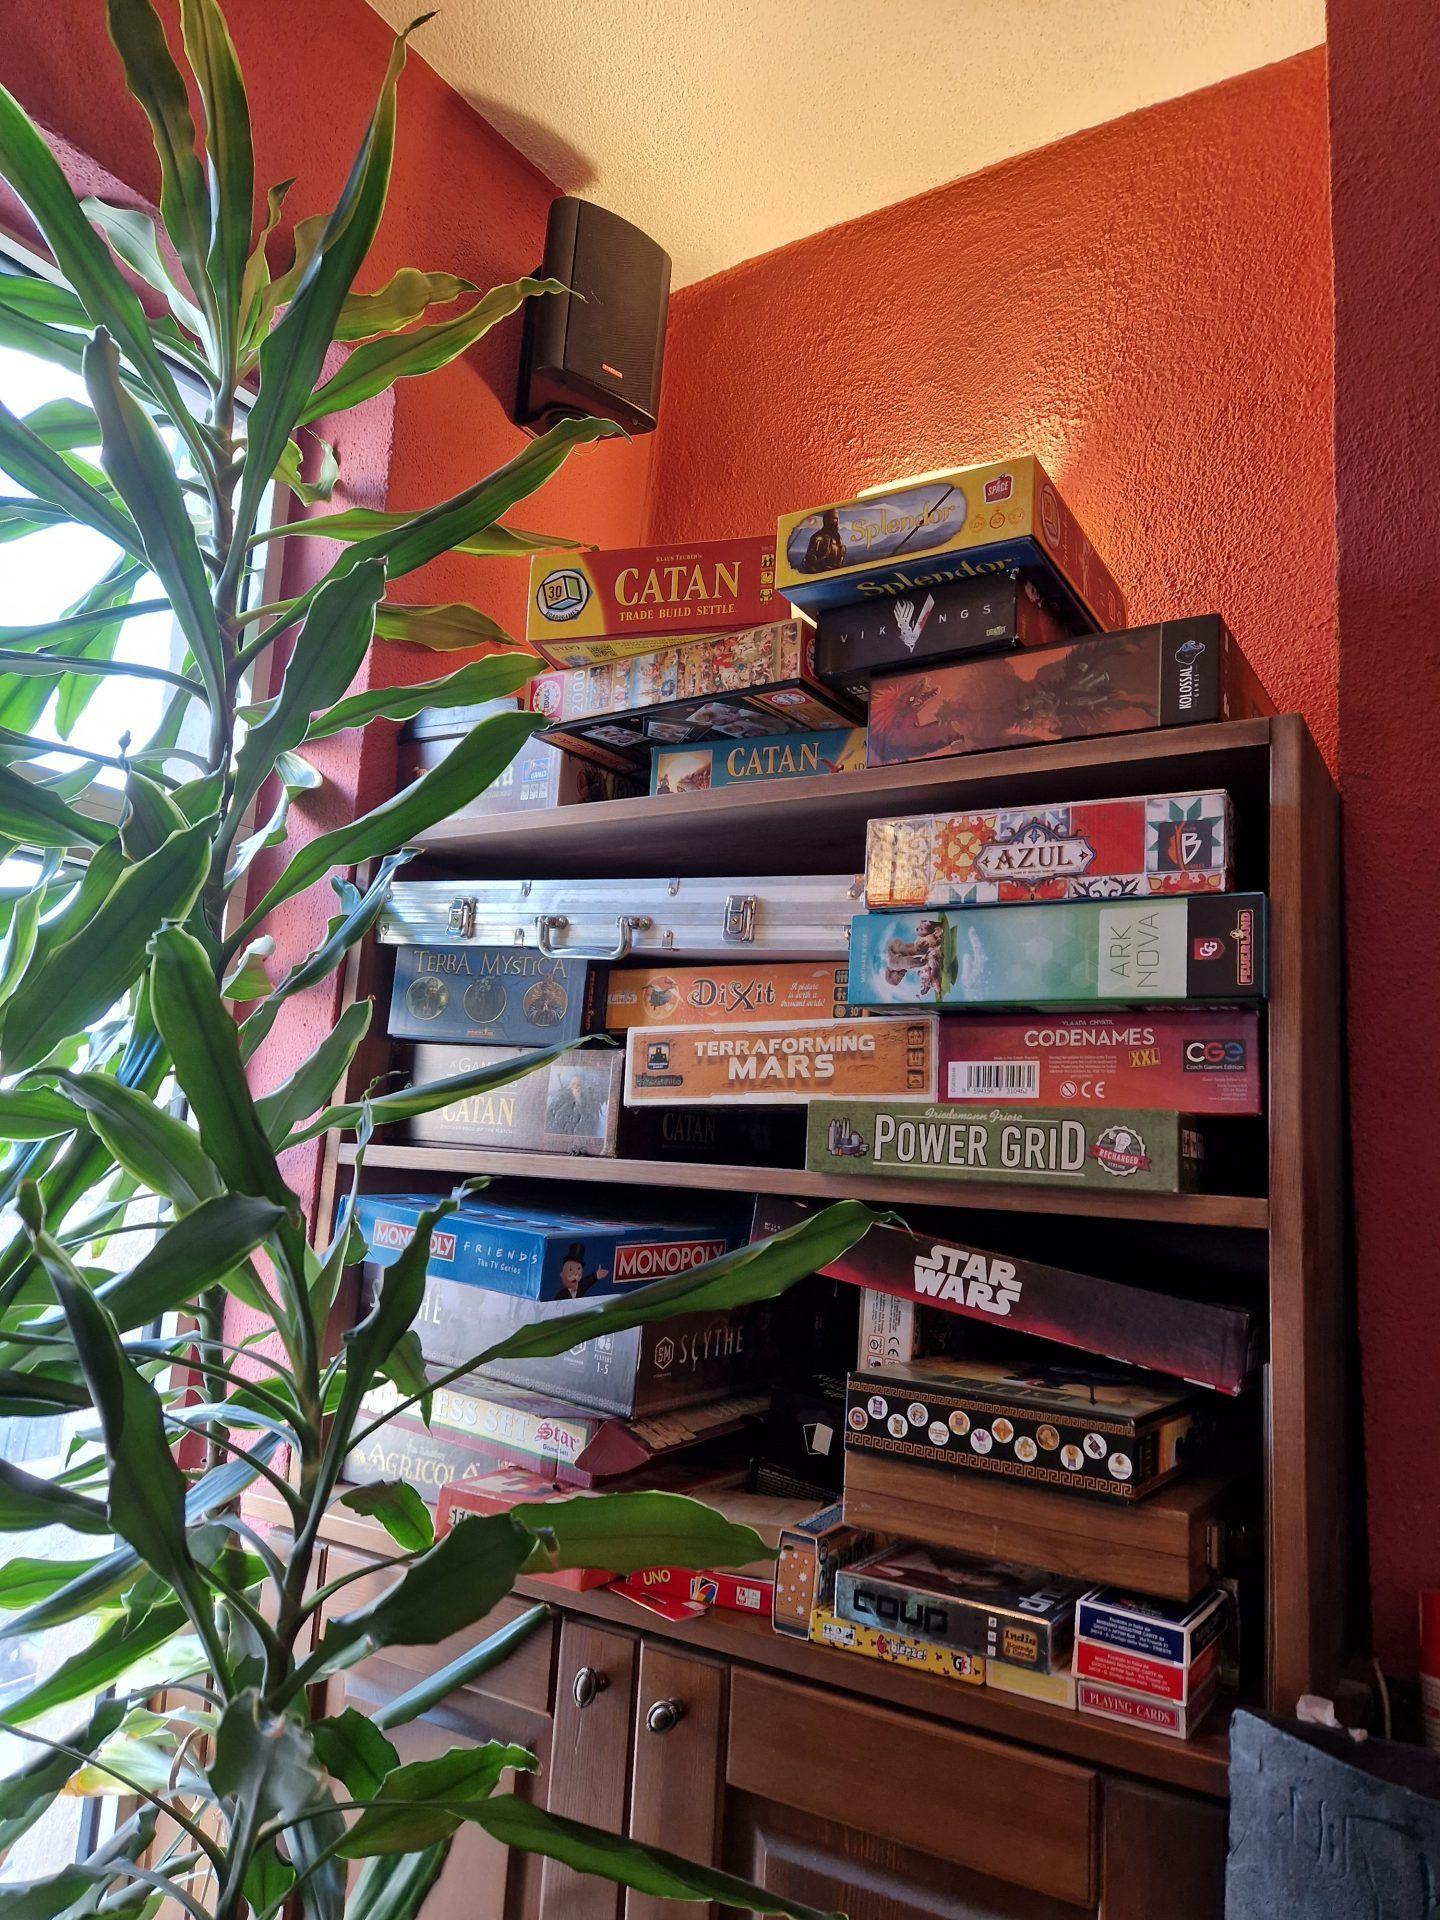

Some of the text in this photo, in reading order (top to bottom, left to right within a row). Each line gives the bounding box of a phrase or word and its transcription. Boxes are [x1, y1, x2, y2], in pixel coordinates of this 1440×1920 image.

[988, 482, 1008, 496] SPACE
[850, 501, 956, 551] Splendor
[614, 561, 742, 606] CATAN
[856, 557, 1014, 597] Splendor
[548, 585, 562, 599] 30
[619, 603, 735, 621] TRADE BUILD SETTLE
[571, 670, 586, 715] 2000
[1179, 665, 1193, 709] KOLOSSAL
[727, 742, 819, 777] CATAN
[995, 845, 1073, 871] AZUL
[413, 950, 569, 979] TERRA MYSTICA
[1110, 925, 1132, 978] ARK
[1137, 912, 1160, 988] NOVA
[849, 1006, 859, 1017] 30
[694, 1034, 876, 1057] TERRAFORMING
[1024, 1028, 1155, 1047] CODENAMES
[728, 1053, 835, 1080] MARS
[1130, 1049, 1159, 1067] XXL
[925, 1107, 988, 1121] Friedemann
[874, 1114, 1086, 1172] POWER GRID
[1098, 1147, 1140, 1165] RECHARGED
[464, 1242, 538, 1265] FRIENDS
[478, 1258, 521, 1275] The TV Series
[914, 1244, 1023, 1293] STAR
[913, 1265, 1021, 1316] WARS
[485, 1406, 529, 1441] SET
[535, 1422, 577, 1452] Star
[643, 1569, 671, 1586] UNO
[1089, 1692, 1171, 1723] PLAYING CARDS
